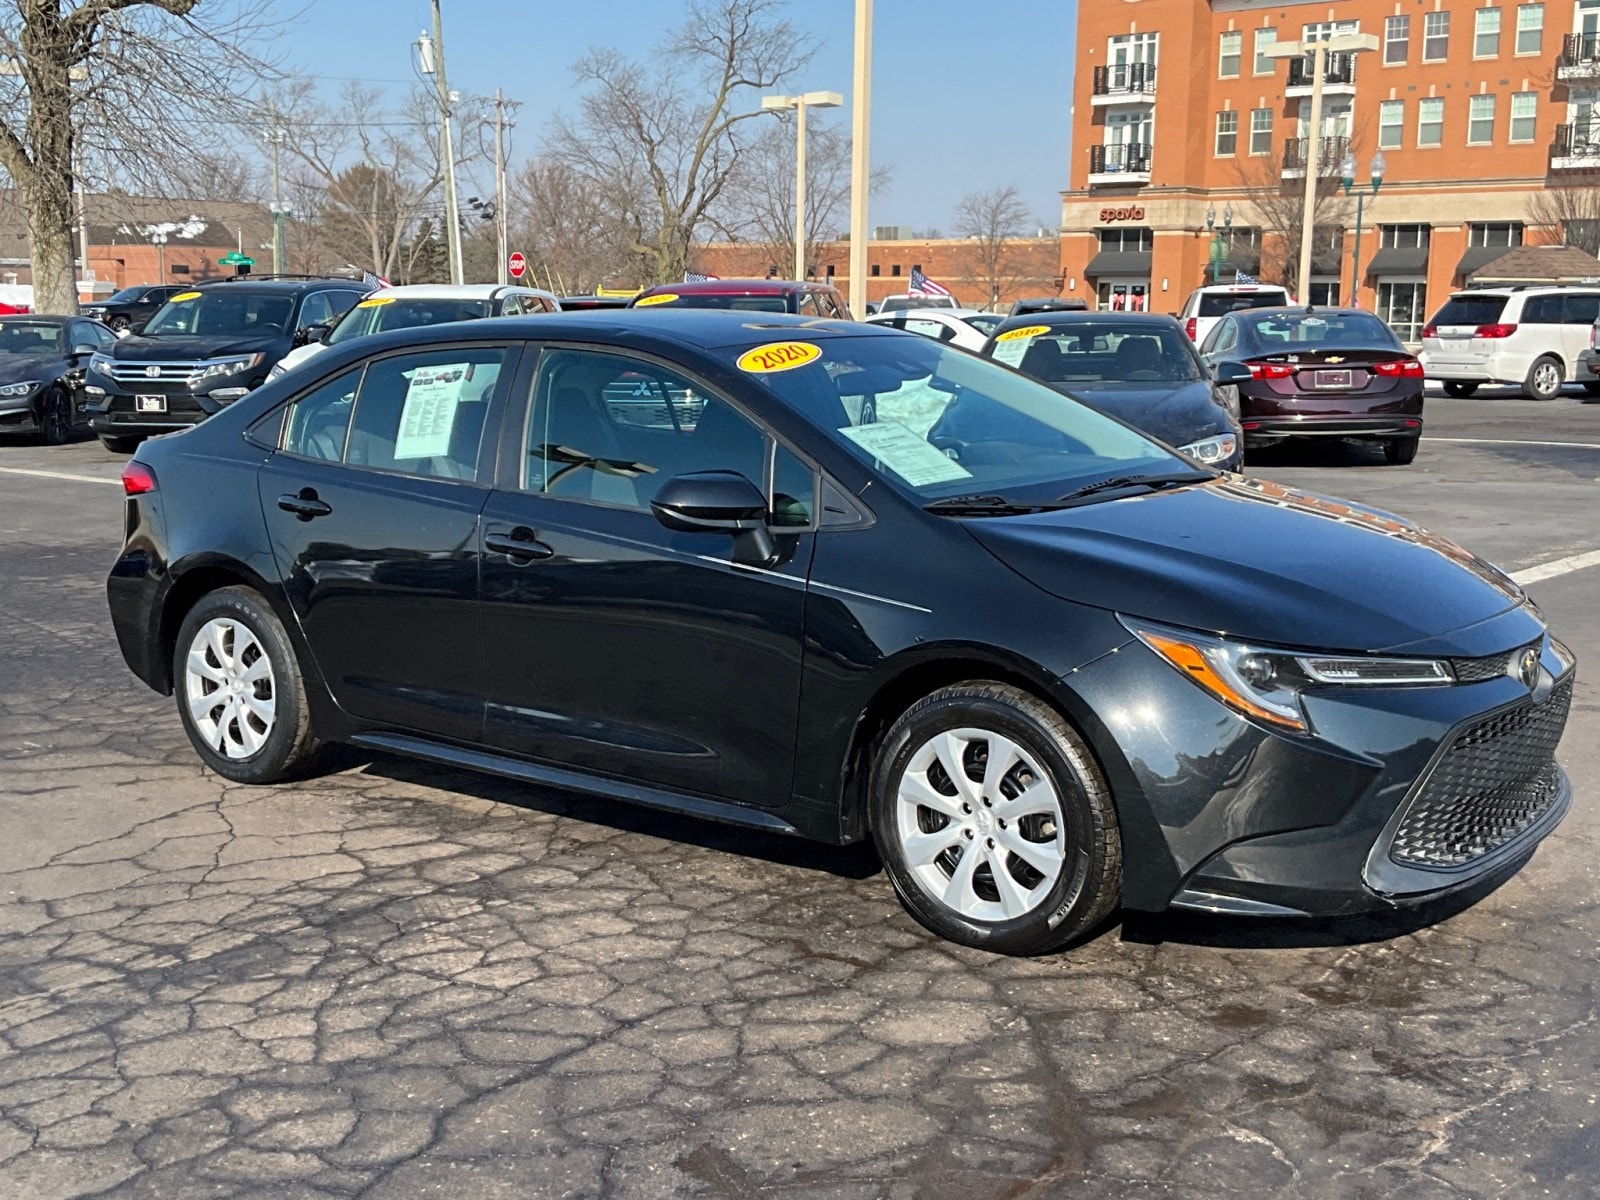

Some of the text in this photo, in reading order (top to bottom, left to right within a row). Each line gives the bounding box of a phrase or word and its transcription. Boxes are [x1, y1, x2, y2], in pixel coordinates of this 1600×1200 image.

[1099, 204, 1145, 224] spavia
[510, 259, 525, 269] STOP
[1004, 328, 1040, 340] 2016
[752, 345, 809, 369] 2020
